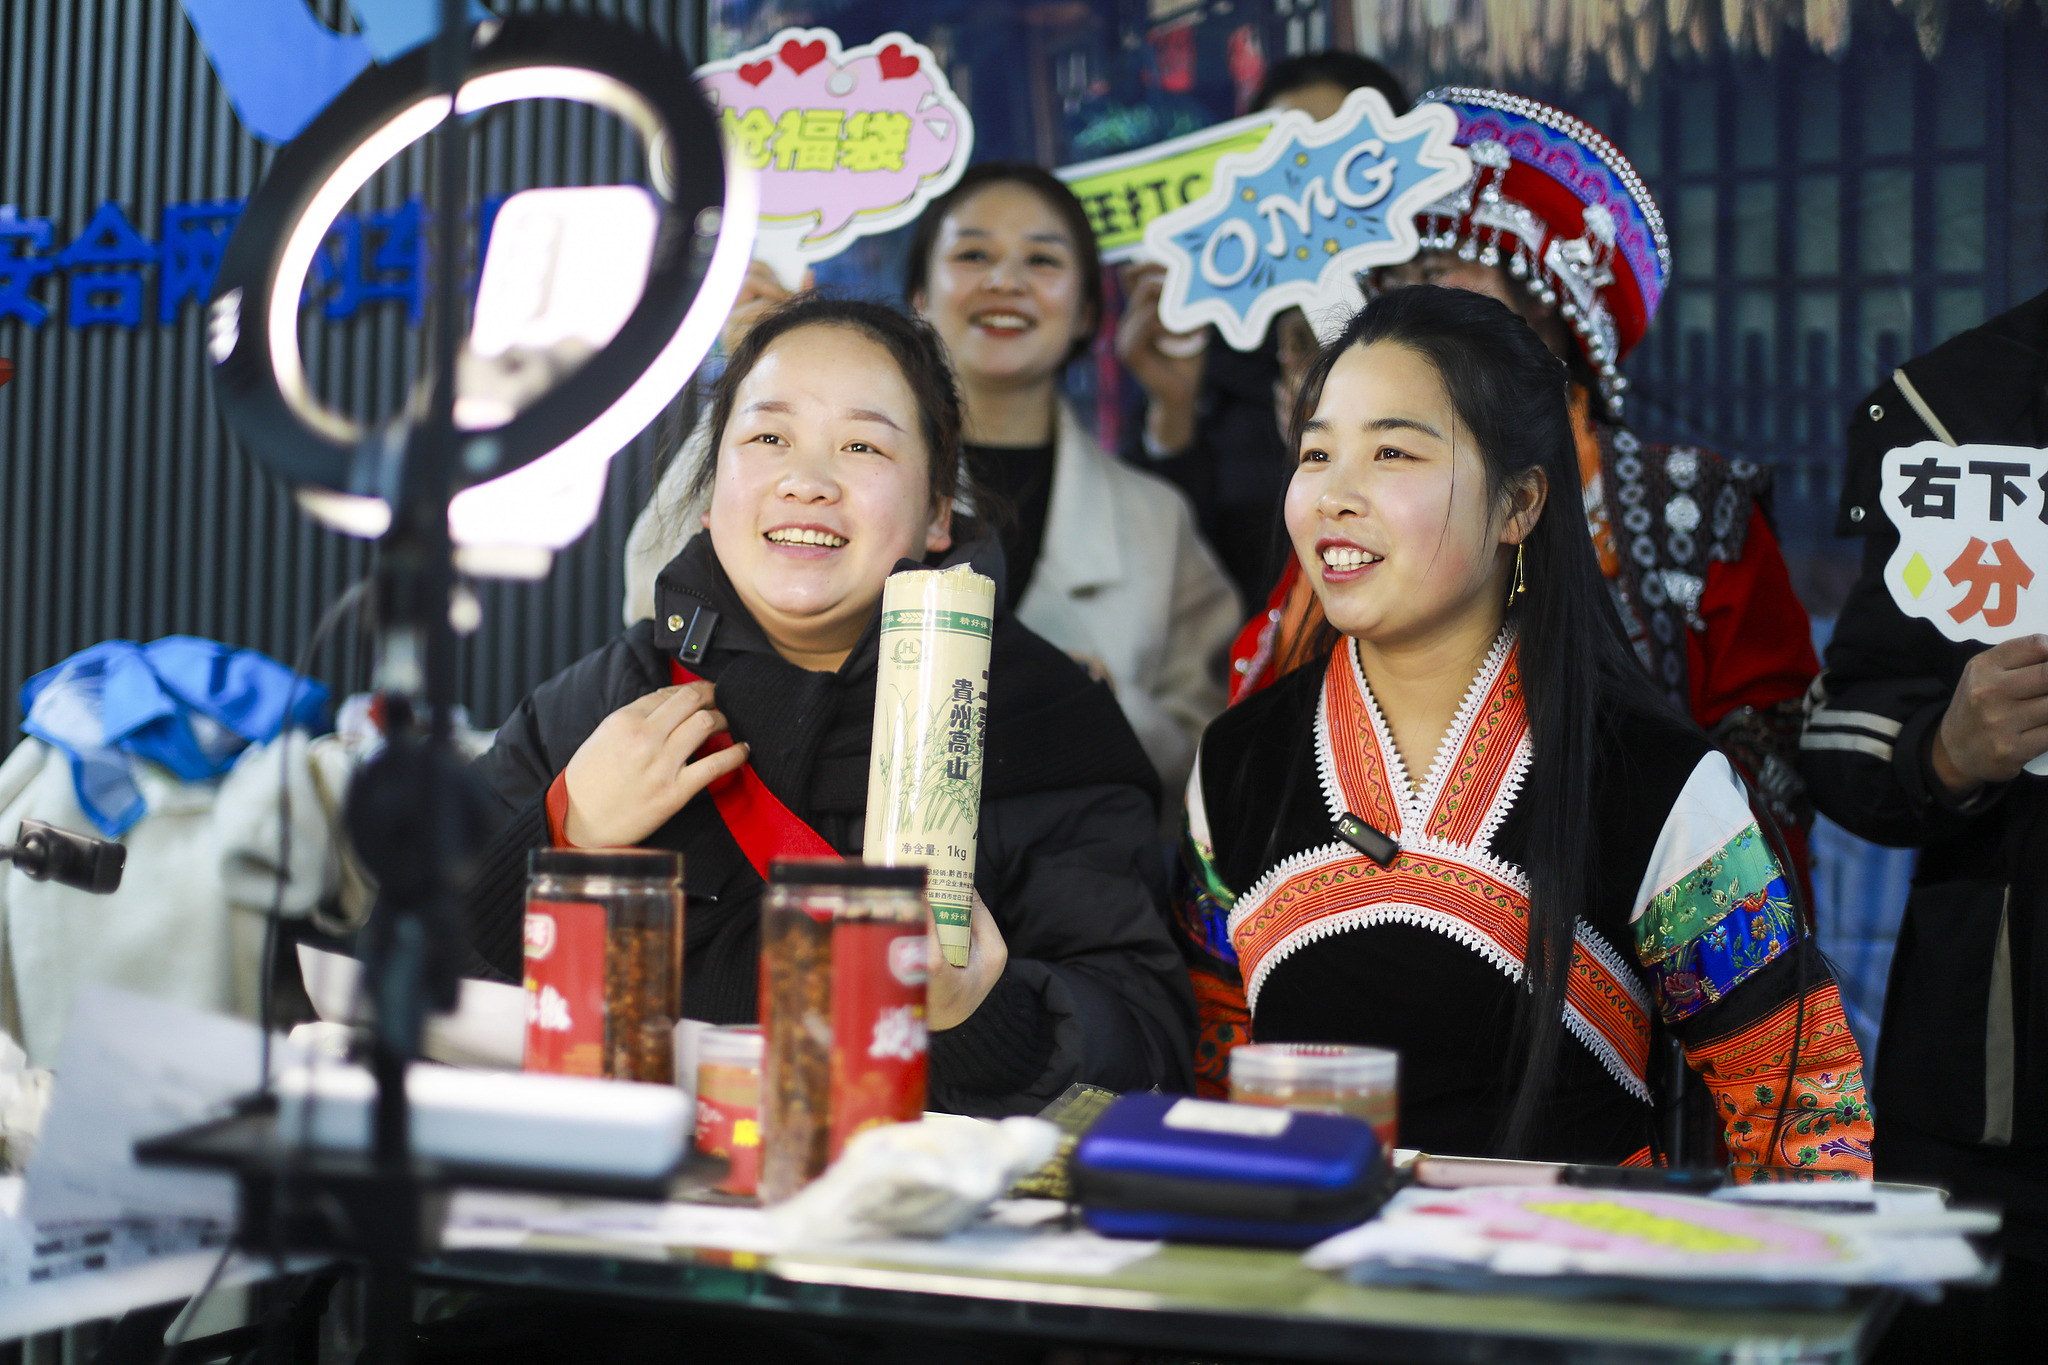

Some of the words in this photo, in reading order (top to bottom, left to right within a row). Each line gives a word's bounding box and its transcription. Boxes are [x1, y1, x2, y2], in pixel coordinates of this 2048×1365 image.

[1201, 138, 1398, 288] OMG
[1898, 457, 2048, 526] 右下
[1943, 536, 2036, 628] 分
[946, 678, 975, 781] 貴州高山
[947, 844, 968, 861] 1kg
